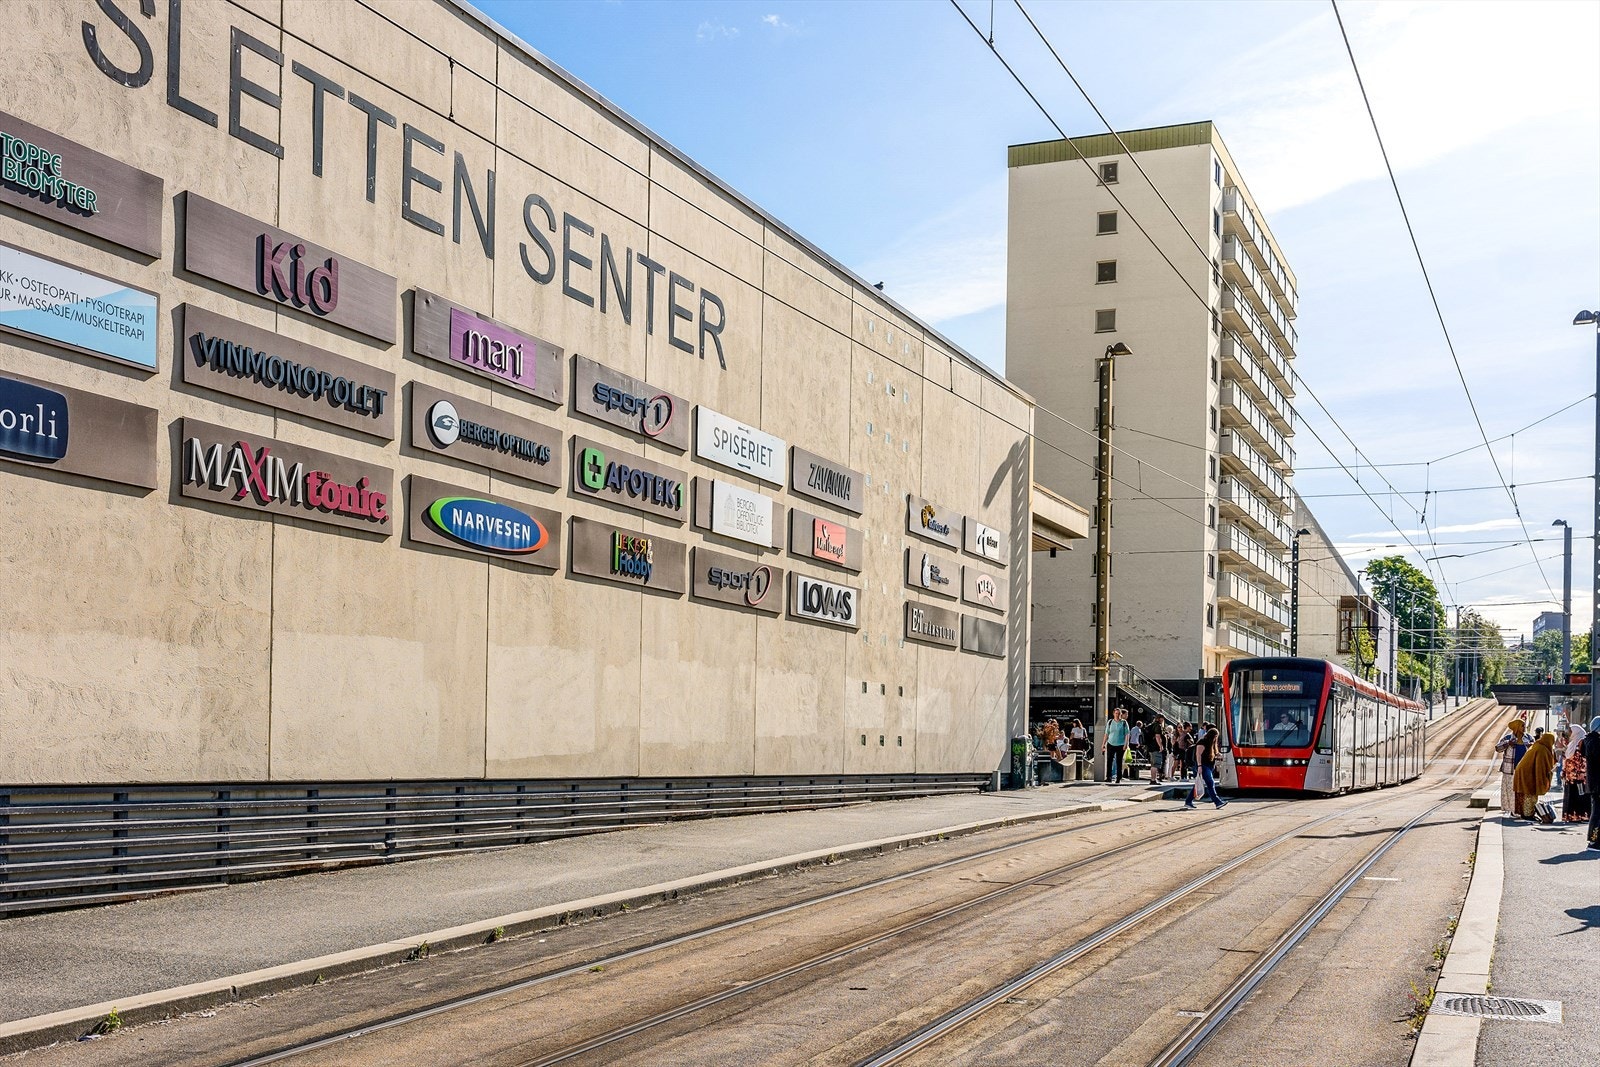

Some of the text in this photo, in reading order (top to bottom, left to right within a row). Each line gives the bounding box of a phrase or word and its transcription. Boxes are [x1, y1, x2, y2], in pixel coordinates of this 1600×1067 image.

[0, 131, 62, 176] TOPPE
[2, 156, 99, 214] BLOMSTER
[82, 0, 727, 371] SLETTEN SENTER
[259, 233, 339, 315] Kid
[17, 293, 145, 342] MASSASJE/MUSKELTERAPI
[20, 277, 80, 305] OSTEOPATI
[85, 297, 145, 326] FYSIOTERAPI
[197, 332, 389, 416] VINMONOPOLET
[467, 329, 524, 378] mani
[0, 402, 59, 441] orli
[459, 418, 550, 463] BERGEN OPTIKK AS
[189, 437, 304, 503] MAXIM
[713, 426, 774, 469] SPISERIET
[807, 462, 852, 501] ZAVANNA
[452, 507, 531, 542] NARVESEN
[736, 497, 757, 513] BERGEN
[620, 553, 653, 582] Hobby
[1260, 683, 1278, 692] Bergen
[1279, 684, 1300, 692] sentrum
